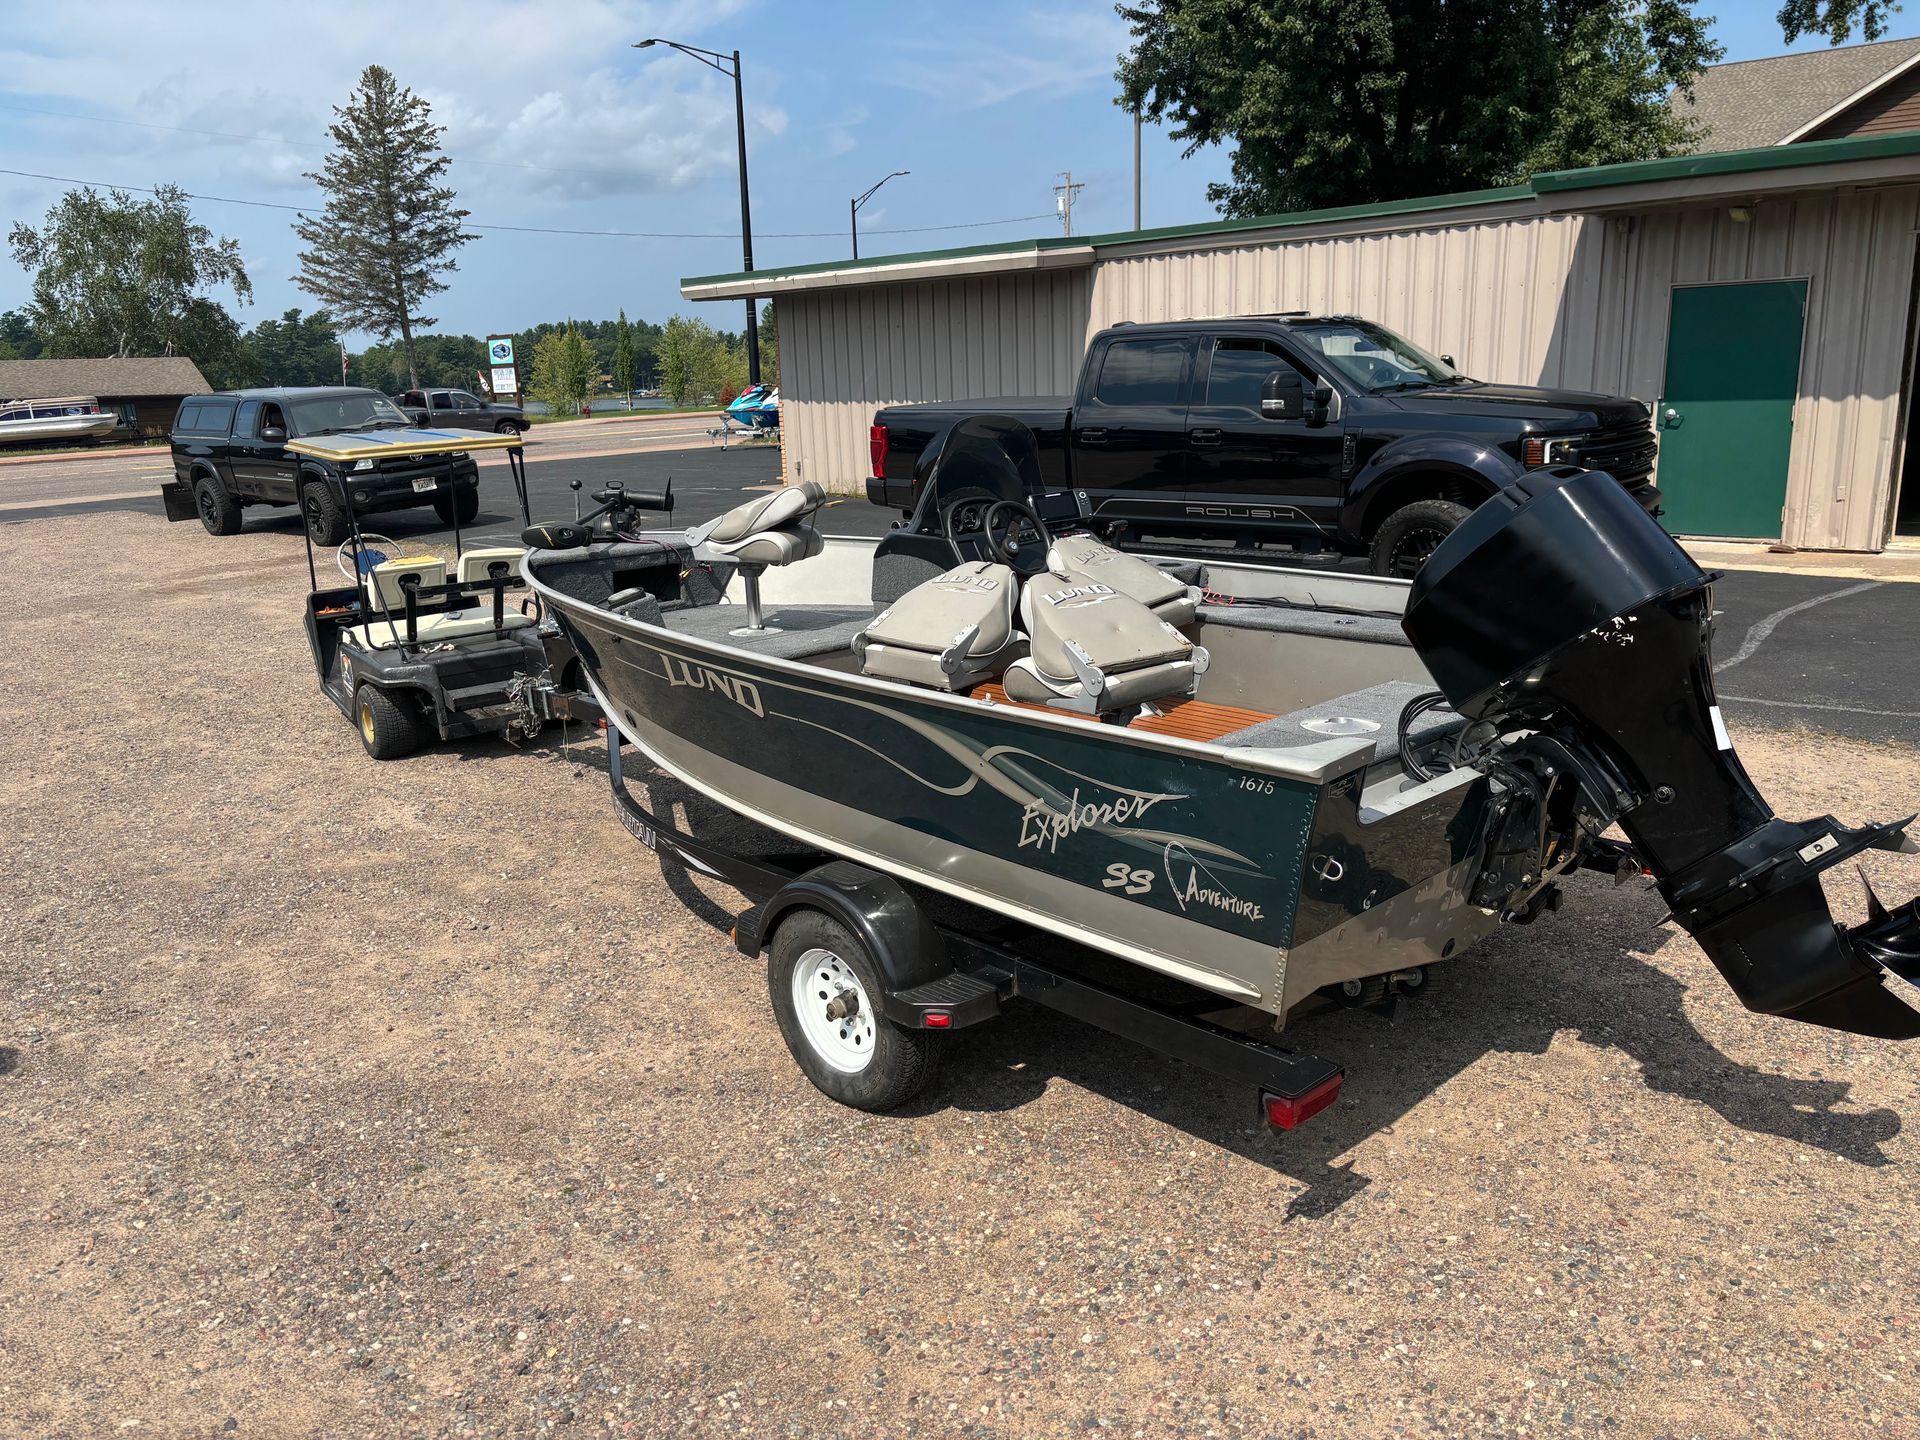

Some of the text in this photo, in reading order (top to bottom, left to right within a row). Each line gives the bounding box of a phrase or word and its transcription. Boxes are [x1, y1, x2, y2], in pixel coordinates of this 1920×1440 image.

[1185, 506, 1295, 519] ROUSH
[932, 574, 999, 591] LUND
[1041, 584, 1116, 606] LUND
[659, 654, 765, 718] LUND
[1239, 775, 1276, 795] 1675
[614, 797, 656, 850] ARTAN
[1017, 787, 1168, 854] Explorer
[1102, 862, 1155, 895] SS
[1185, 865, 1265, 922] ADVENTURE
